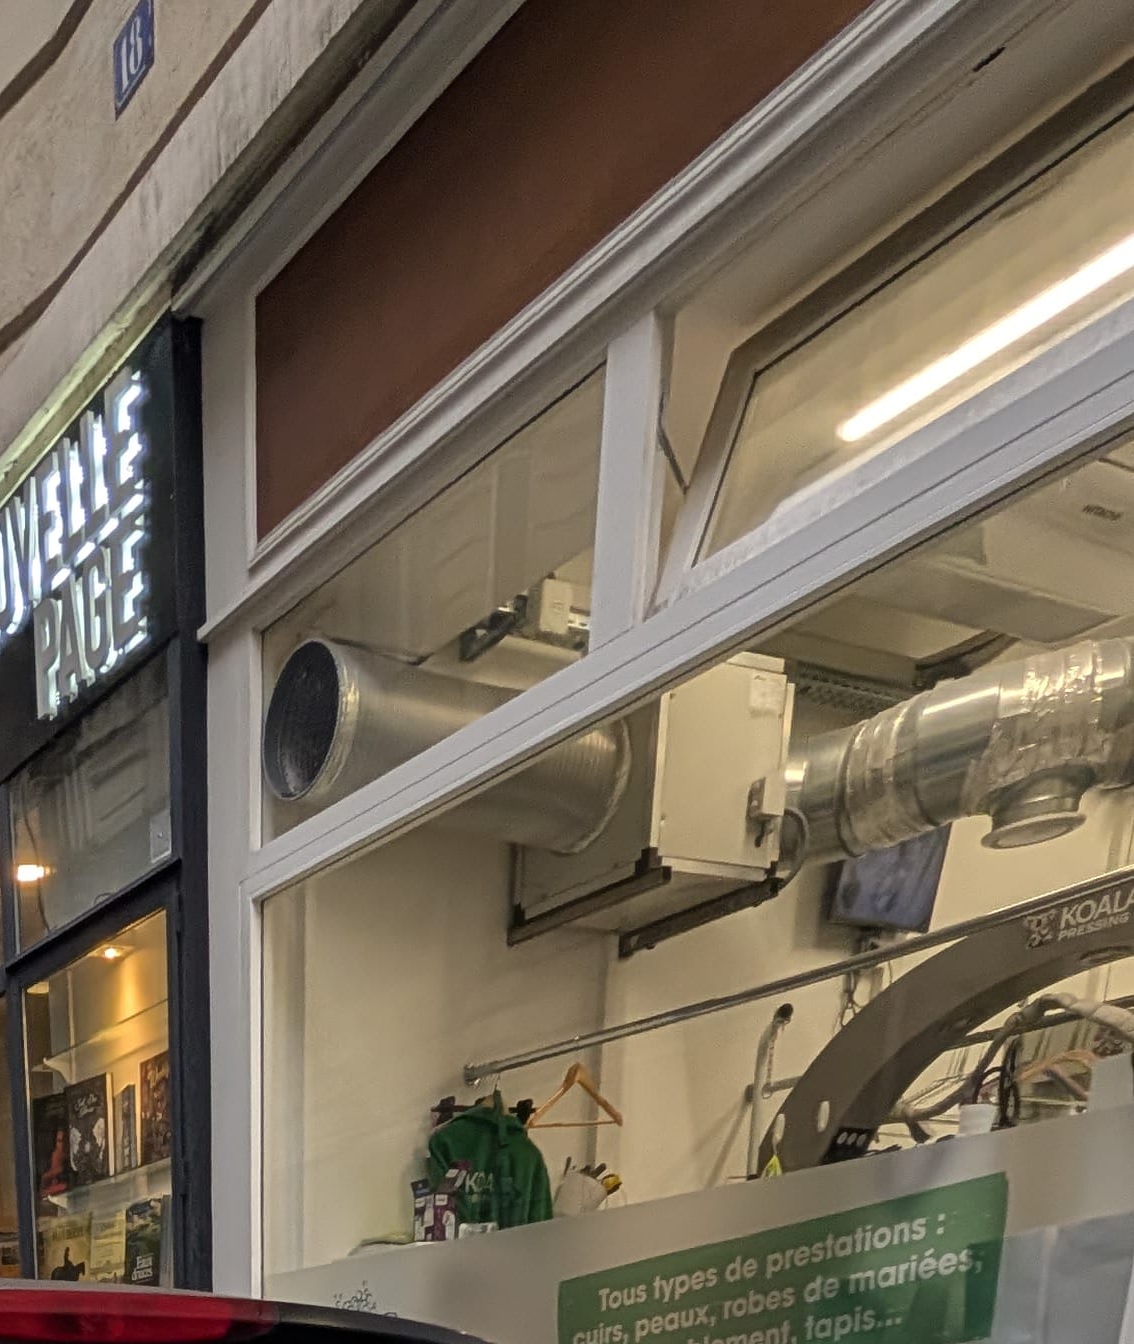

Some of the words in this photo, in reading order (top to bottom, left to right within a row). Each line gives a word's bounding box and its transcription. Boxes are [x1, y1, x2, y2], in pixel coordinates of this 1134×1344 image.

[32, 512, 149, 721] PAGE
[1057, 911, 1131, 941] PRESSING
[598, 1282, 647, 1312] Tous
[653, 1267, 718, 1303] types
[725, 1255, 759, 1283] de
[765, 1214, 927, 1279] prestations
[635, 1302, 717, 1343] peaux,
[723, 1284, 796, 1319] robes
[803, 1272, 841, 1303] de
[849, 1245, 984, 1294] mariées,
[805, 1305, 904, 1342] tapis...
